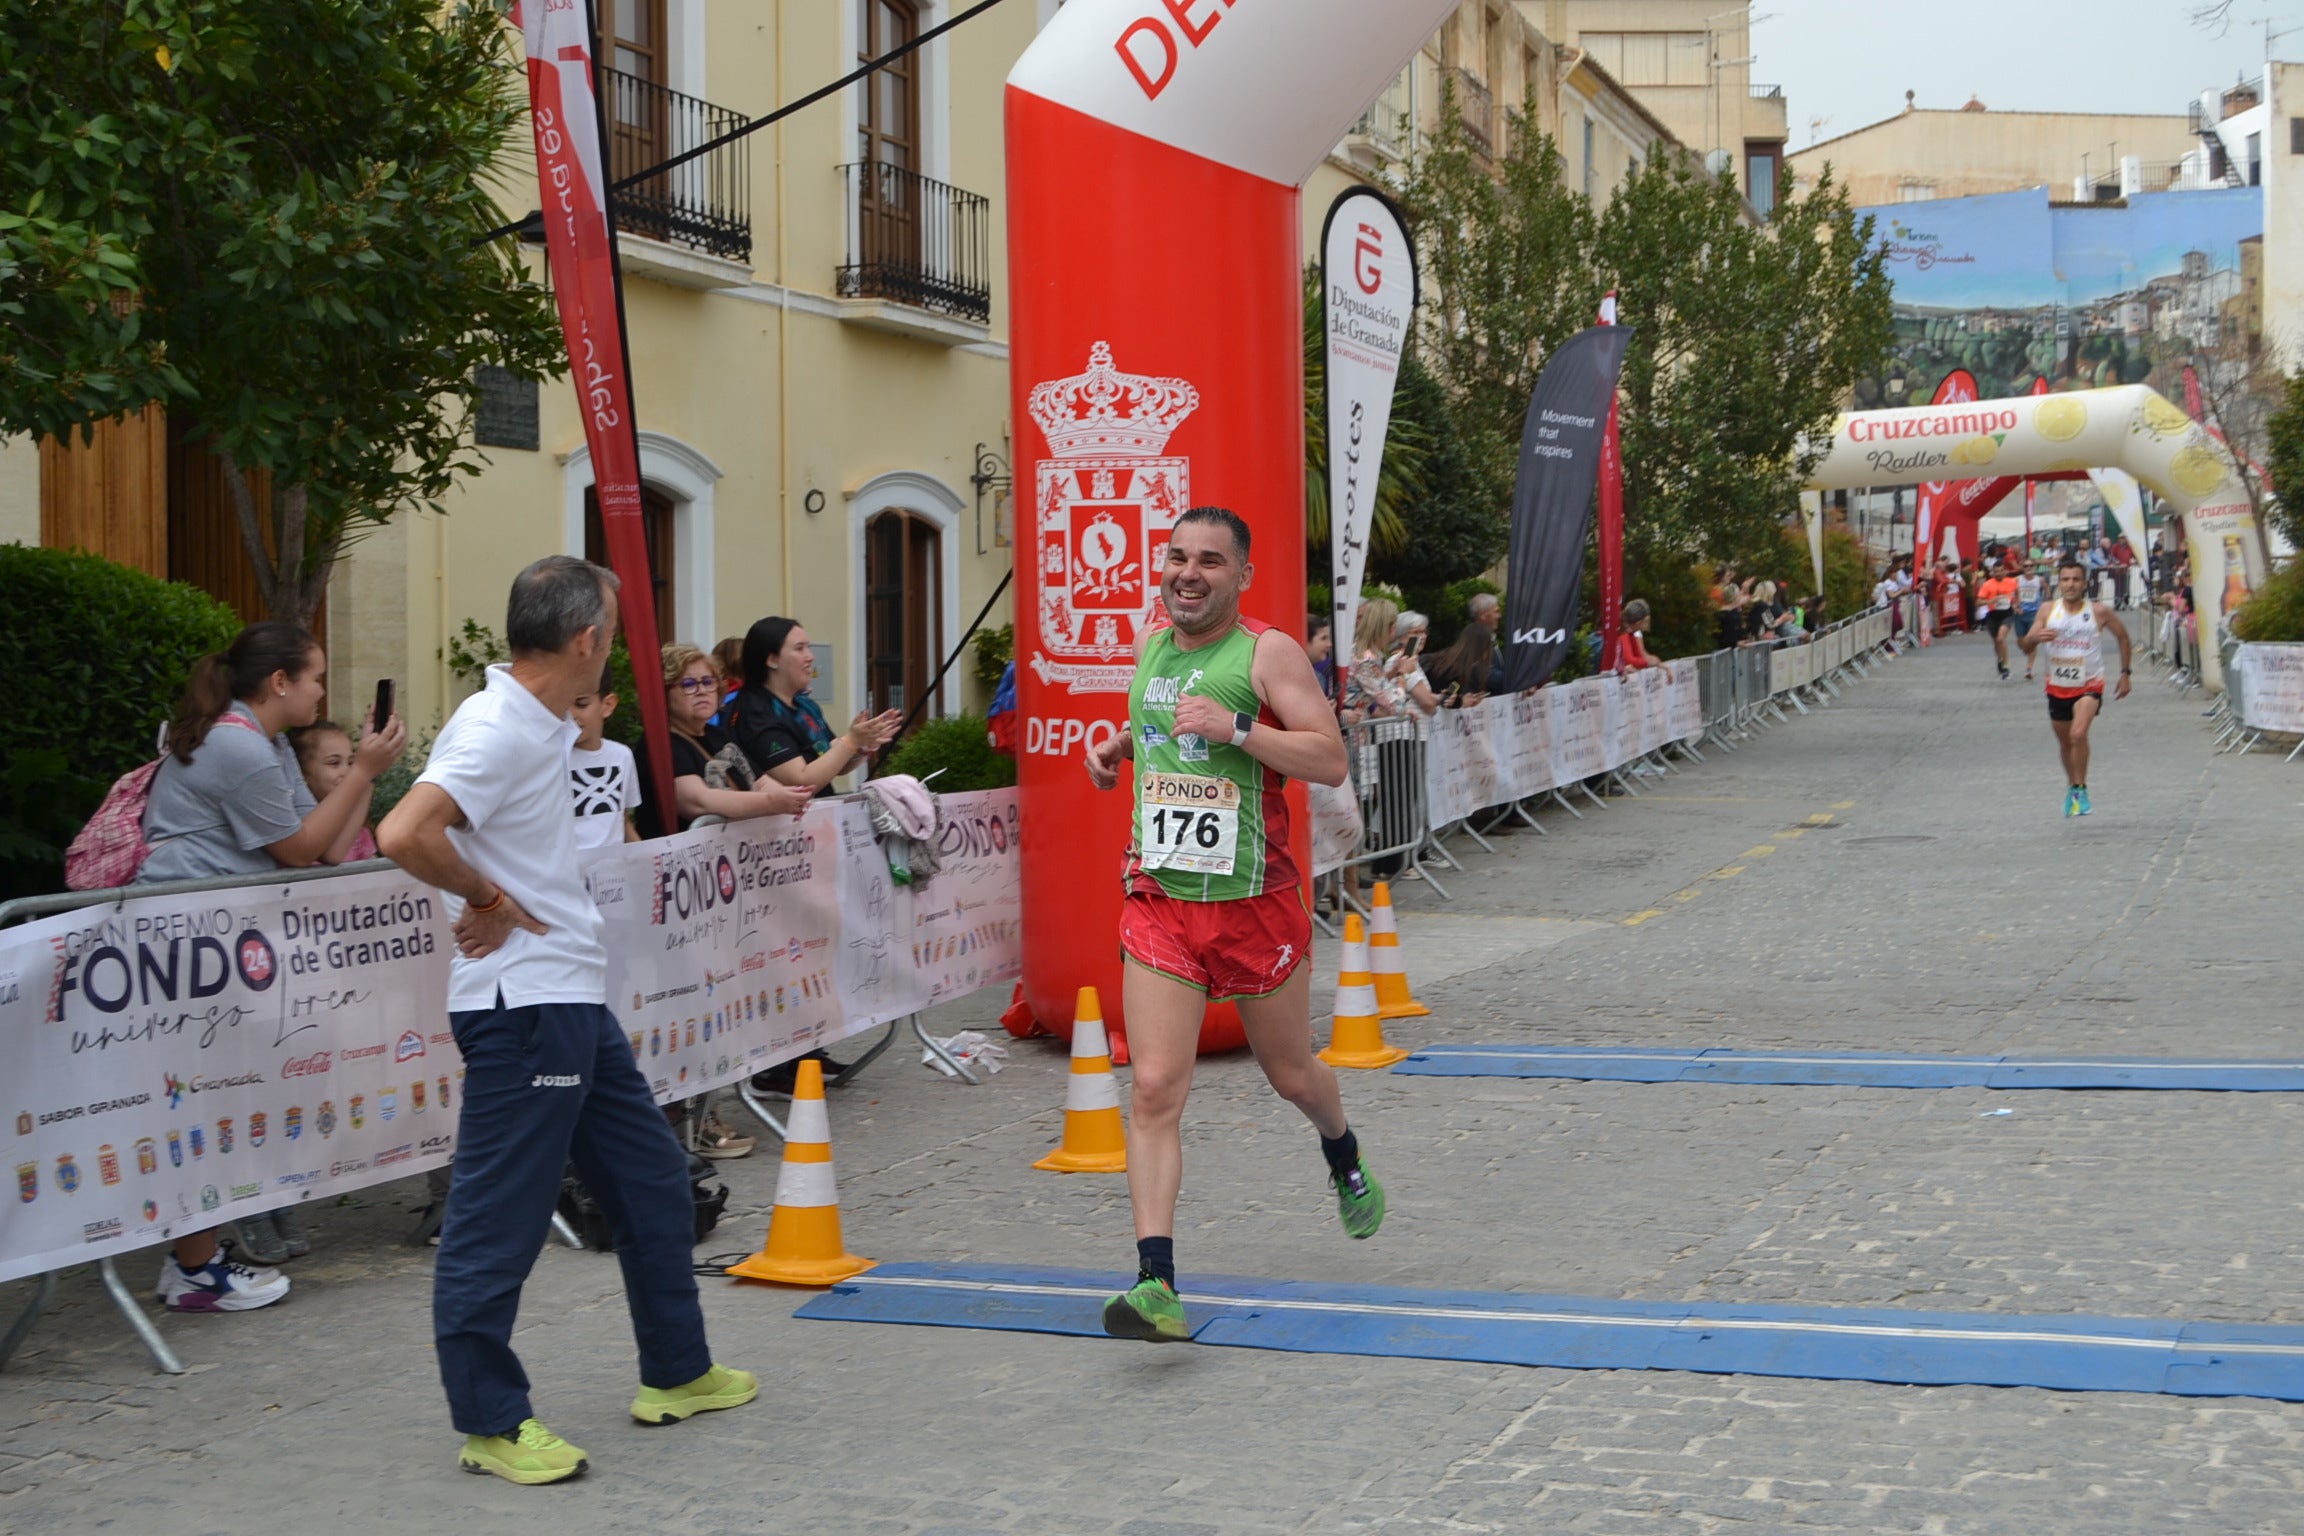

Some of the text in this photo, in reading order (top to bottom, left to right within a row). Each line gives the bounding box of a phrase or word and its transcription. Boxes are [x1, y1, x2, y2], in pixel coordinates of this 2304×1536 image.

[1114, 0, 1249, 100] DE
[1332, 285, 1399, 330] Diputación
[1348, 319, 1399, 355] Granada
[1538, 426, 1559, 440] that
[1540, 409, 1595, 428] Movement
[1849, 409, 2018, 443] Cruzcampo
[1534, 442, 1573, 460] inspires
[1866, 449, 1950, 474] Radler
[2055, 667, 2080, 680] 442
[1142, 703, 1176, 712] Atletism
[1026, 716, 1131, 756] DEPO
[1160, 781, 1219, 800] FONDO
[939, 814, 1007, 858] ONDO
[1153, 808, 1221, 849] 176
[738, 831, 816, 870] Diputación
[661, 854, 737, 925] FONDO
[758, 858, 813, 889] Granada
[283, 890, 432, 942] Diputación
[65, 908, 258, 960] GRAN PREMIO DE
[290, 926, 436, 976] de Granada
[57, 928, 278, 1022] FONDO
[242, 947, 271, 973] 24
[281, 1051, 333, 1079] Coca-Cola
[39, 1092, 151, 1126] SABOR GRANADA
